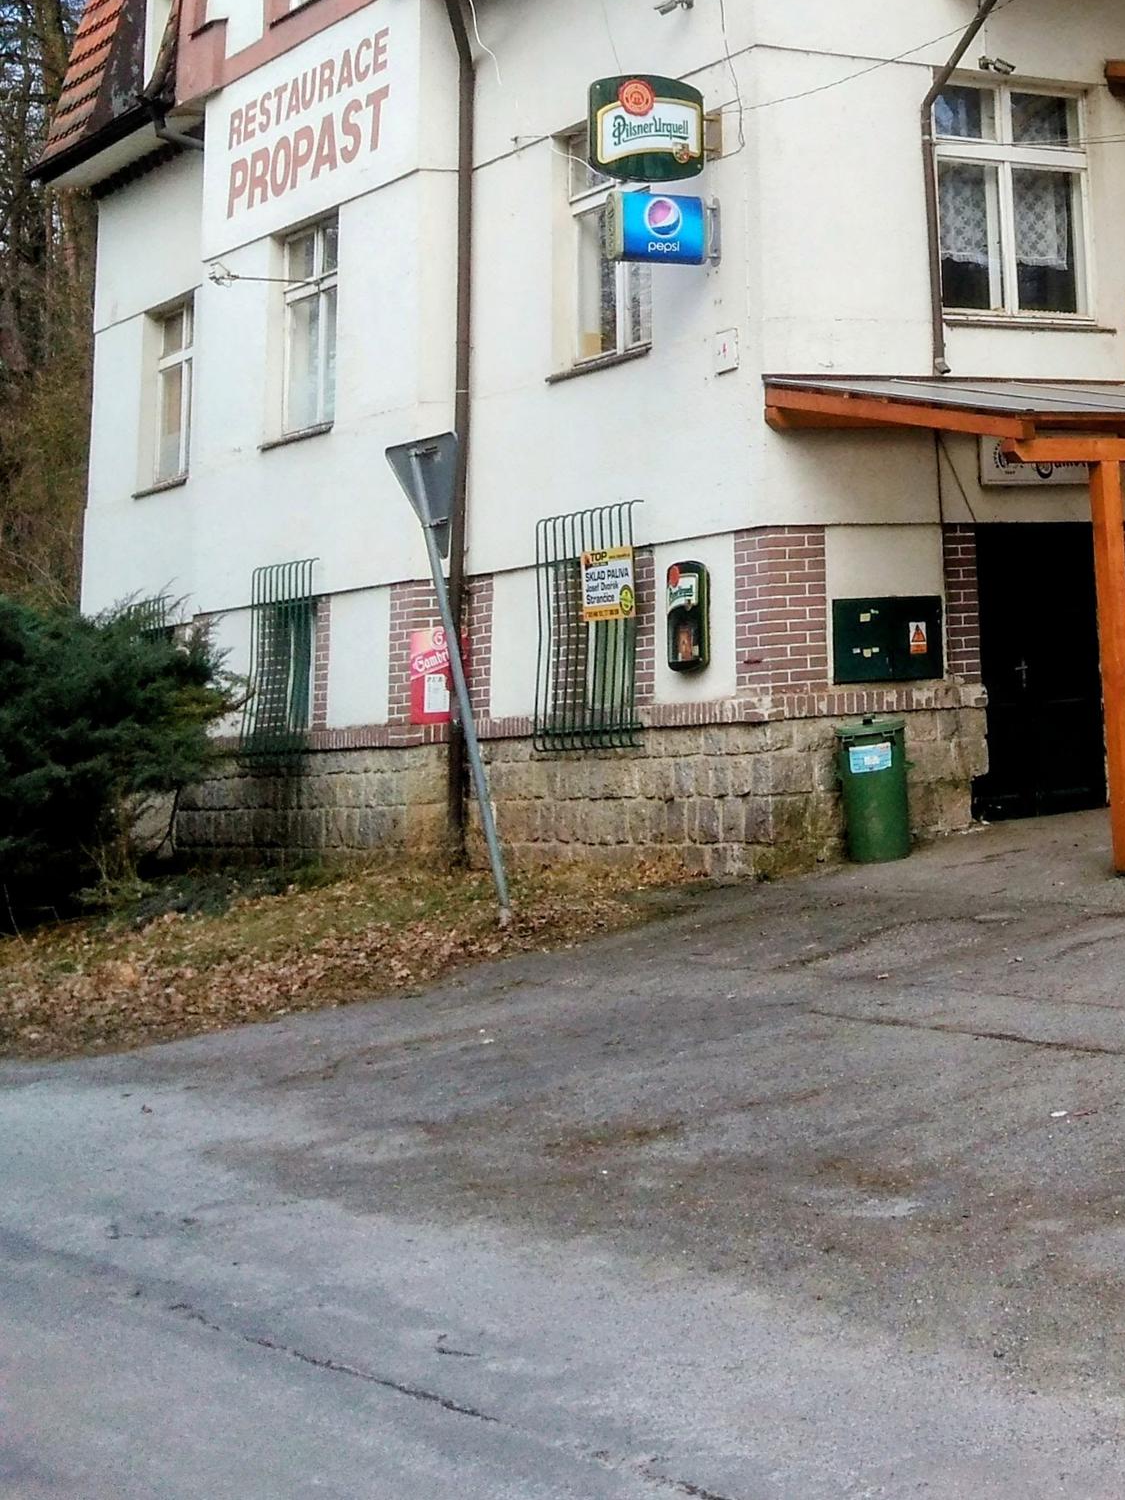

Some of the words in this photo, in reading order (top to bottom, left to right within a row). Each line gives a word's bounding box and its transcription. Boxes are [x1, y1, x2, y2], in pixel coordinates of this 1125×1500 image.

[228, 27, 390, 150] RESTAURACE
[612, 114, 653, 146] Pilsner
[652, 116, 689, 140] Urquell
[227, 84, 390, 219] PROPAST
[648, 241, 680, 253] pepsi
[590, 551, 607, 562] TOP
[585, 570, 606, 582] SKLAD
[606, 567, 629, 580] PALIVA
[412, 648, 450, 673] Gambri
